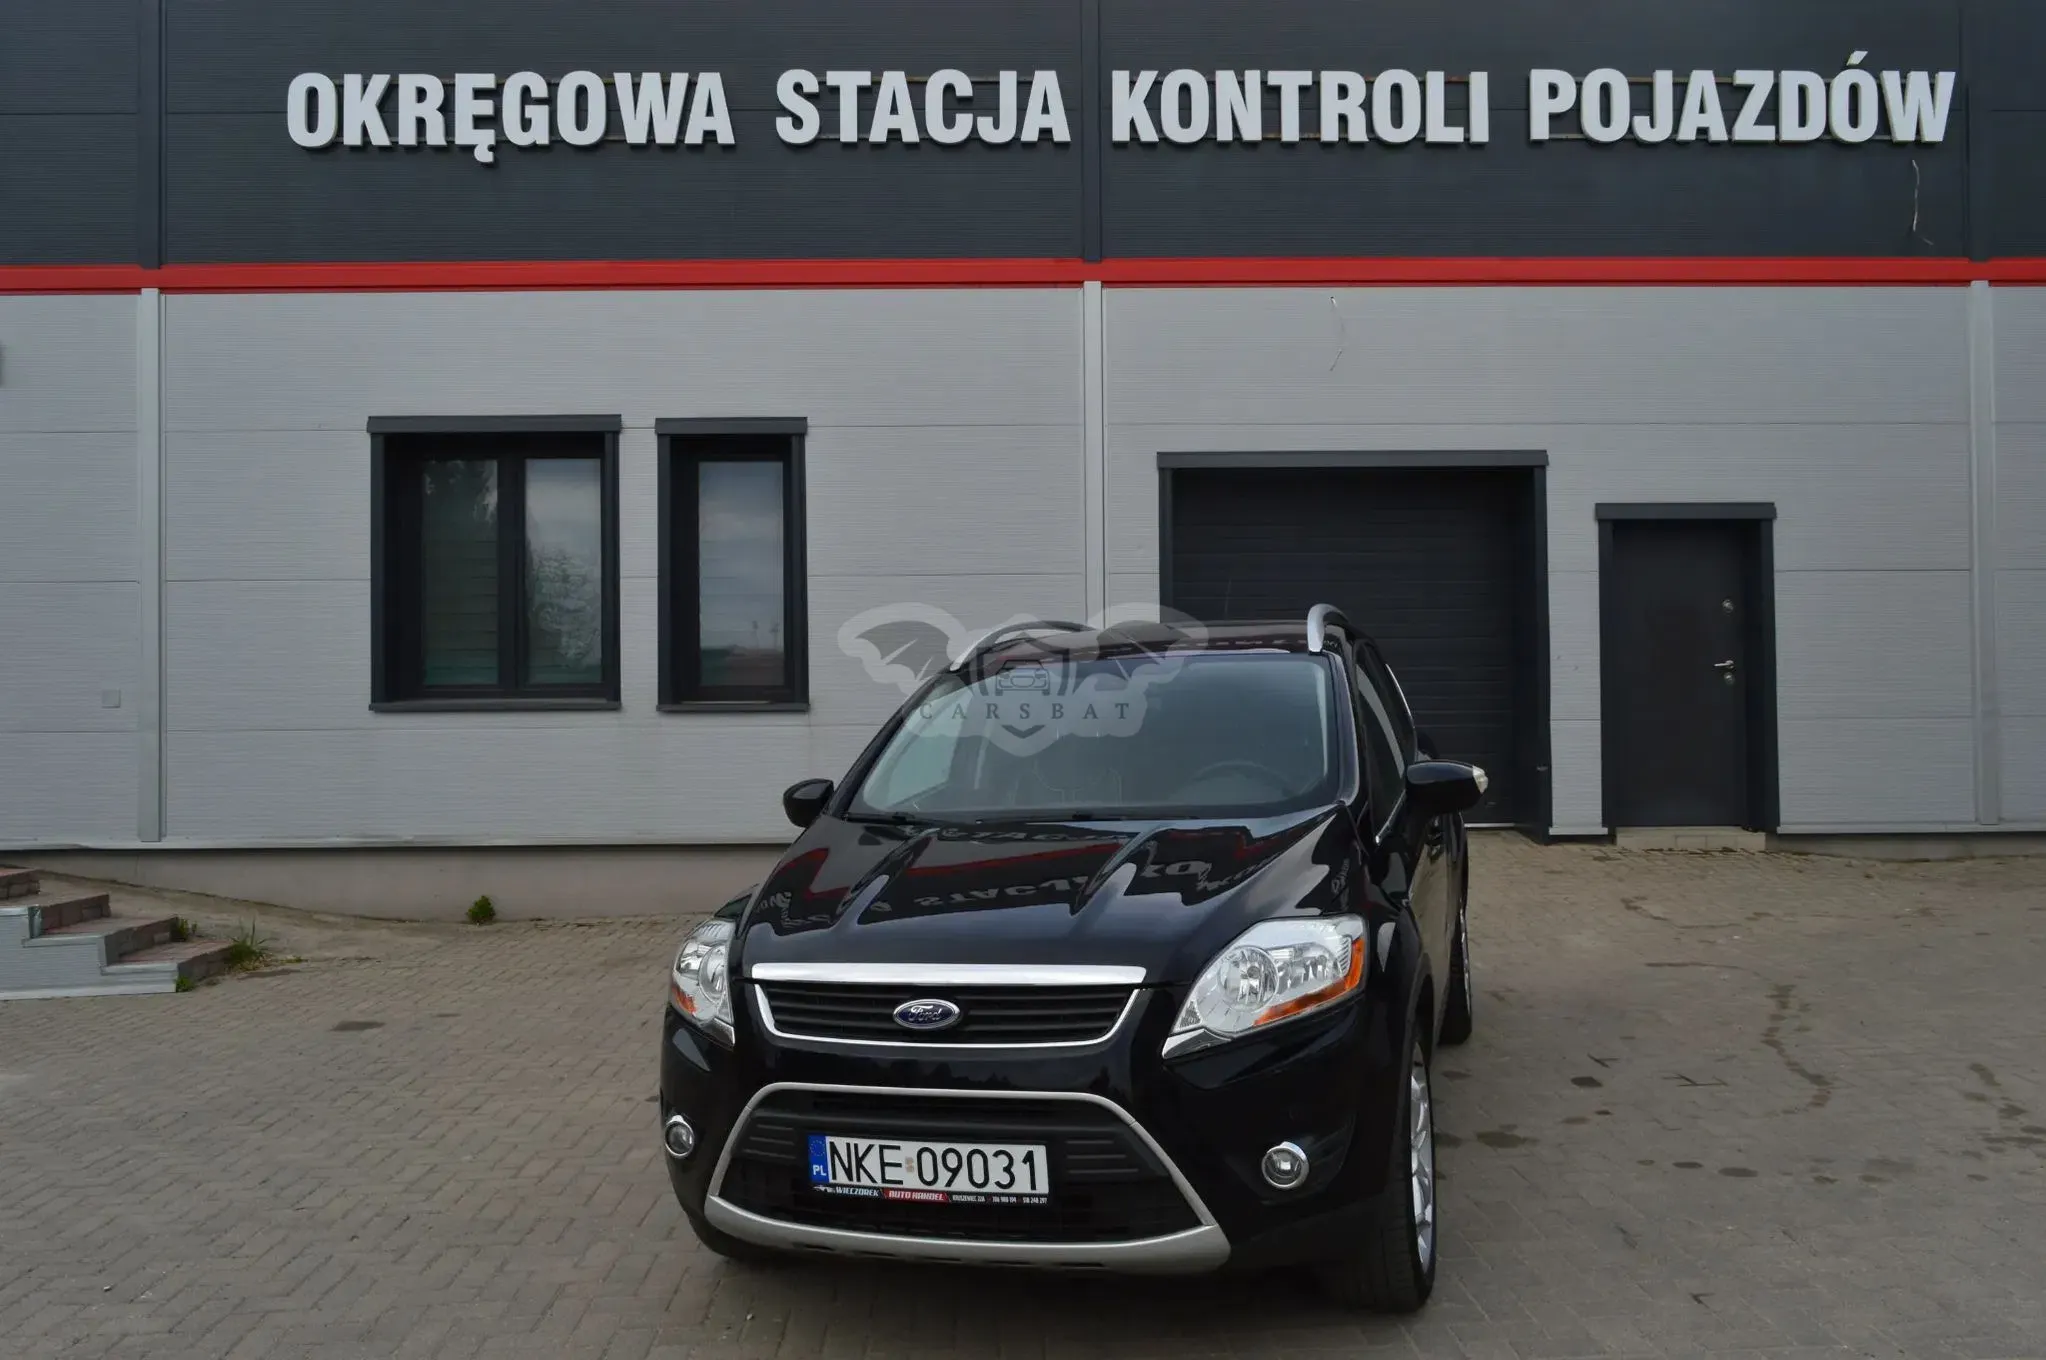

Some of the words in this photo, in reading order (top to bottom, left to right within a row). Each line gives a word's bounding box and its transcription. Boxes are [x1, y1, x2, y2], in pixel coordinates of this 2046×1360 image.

[288, 72, 735, 162] OKRĘGOWA
[776, 69, 1071, 143] STACJA
[1112, 69, 1489, 142] KONTROLI
[1531, 51, 1956, 142] POJAZDÓW
[813, 1164, 827, 1177] PL
[829, 1141, 903, 1185] NKE
[917, 1146, 1037, 1190] 09031
[889, 1190, 911, 1199] AUTO
[912, 1192, 944, 1200] HANDEL
